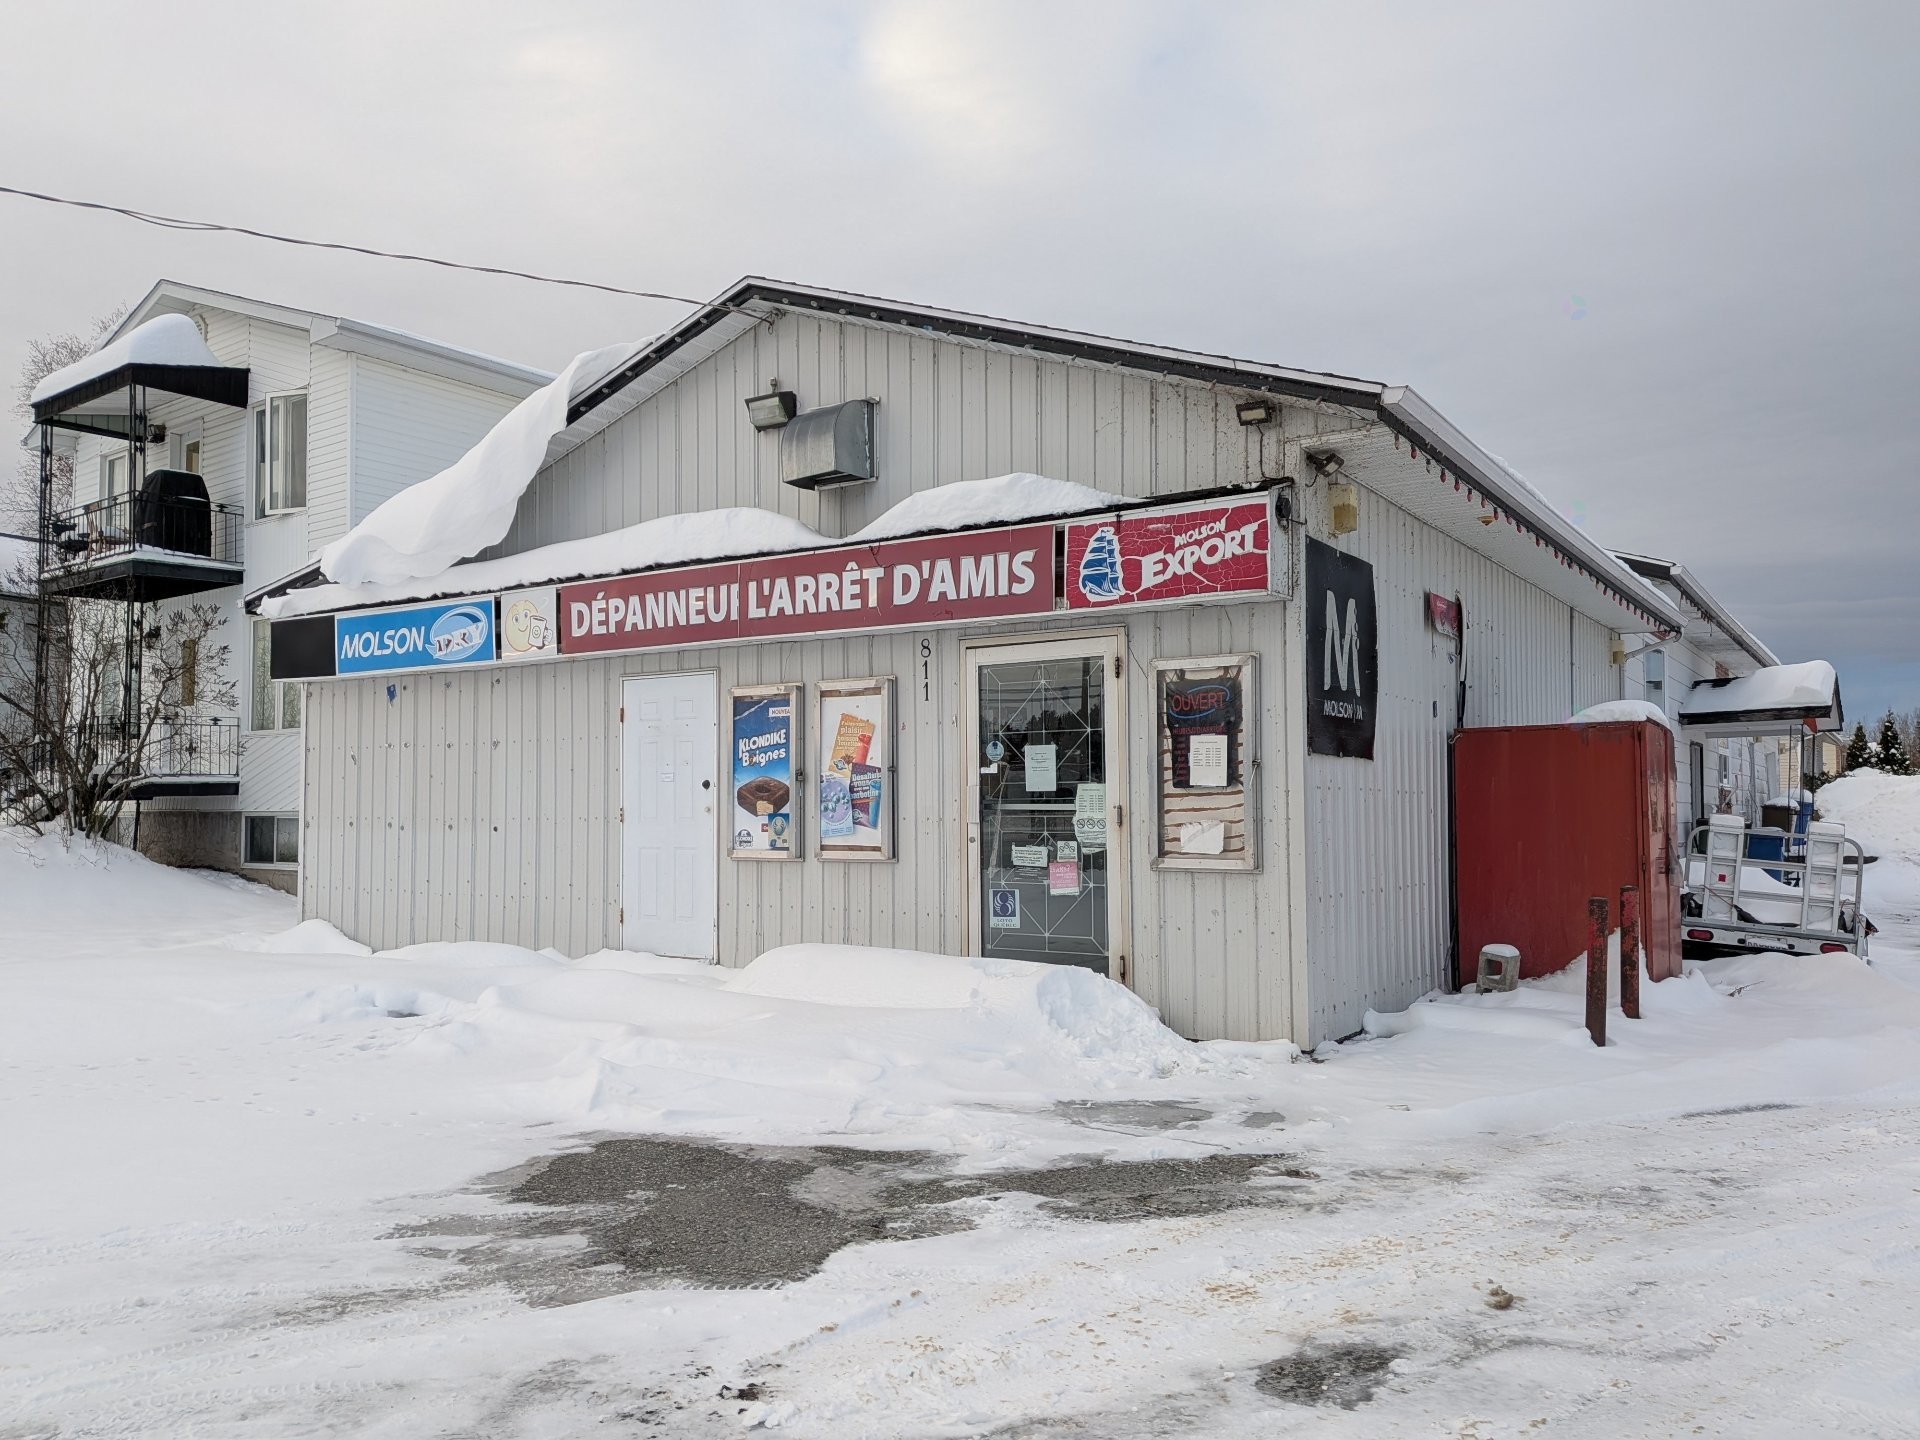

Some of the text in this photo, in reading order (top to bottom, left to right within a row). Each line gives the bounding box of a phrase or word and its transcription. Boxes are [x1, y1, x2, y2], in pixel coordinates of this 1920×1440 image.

[1174, 518, 1227, 549] MOLSON
[1141, 522, 1260, 589] EXPORT
[747, 561, 885, 619] L'ARRÊT
[893, 549, 1039, 606] D'AMIS
[340, 621, 486, 659] MOLSON DRY
[1323, 589, 1361, 698] M
[920, 638, 931, 702] 811
[771, 708, 791, 716] NOUVEA
[1172, 691, 1226, 711] OUVERT
[1323, 699, 1353, 719] MOLSON
[738, 729, 787, 759] KLONDIKE
